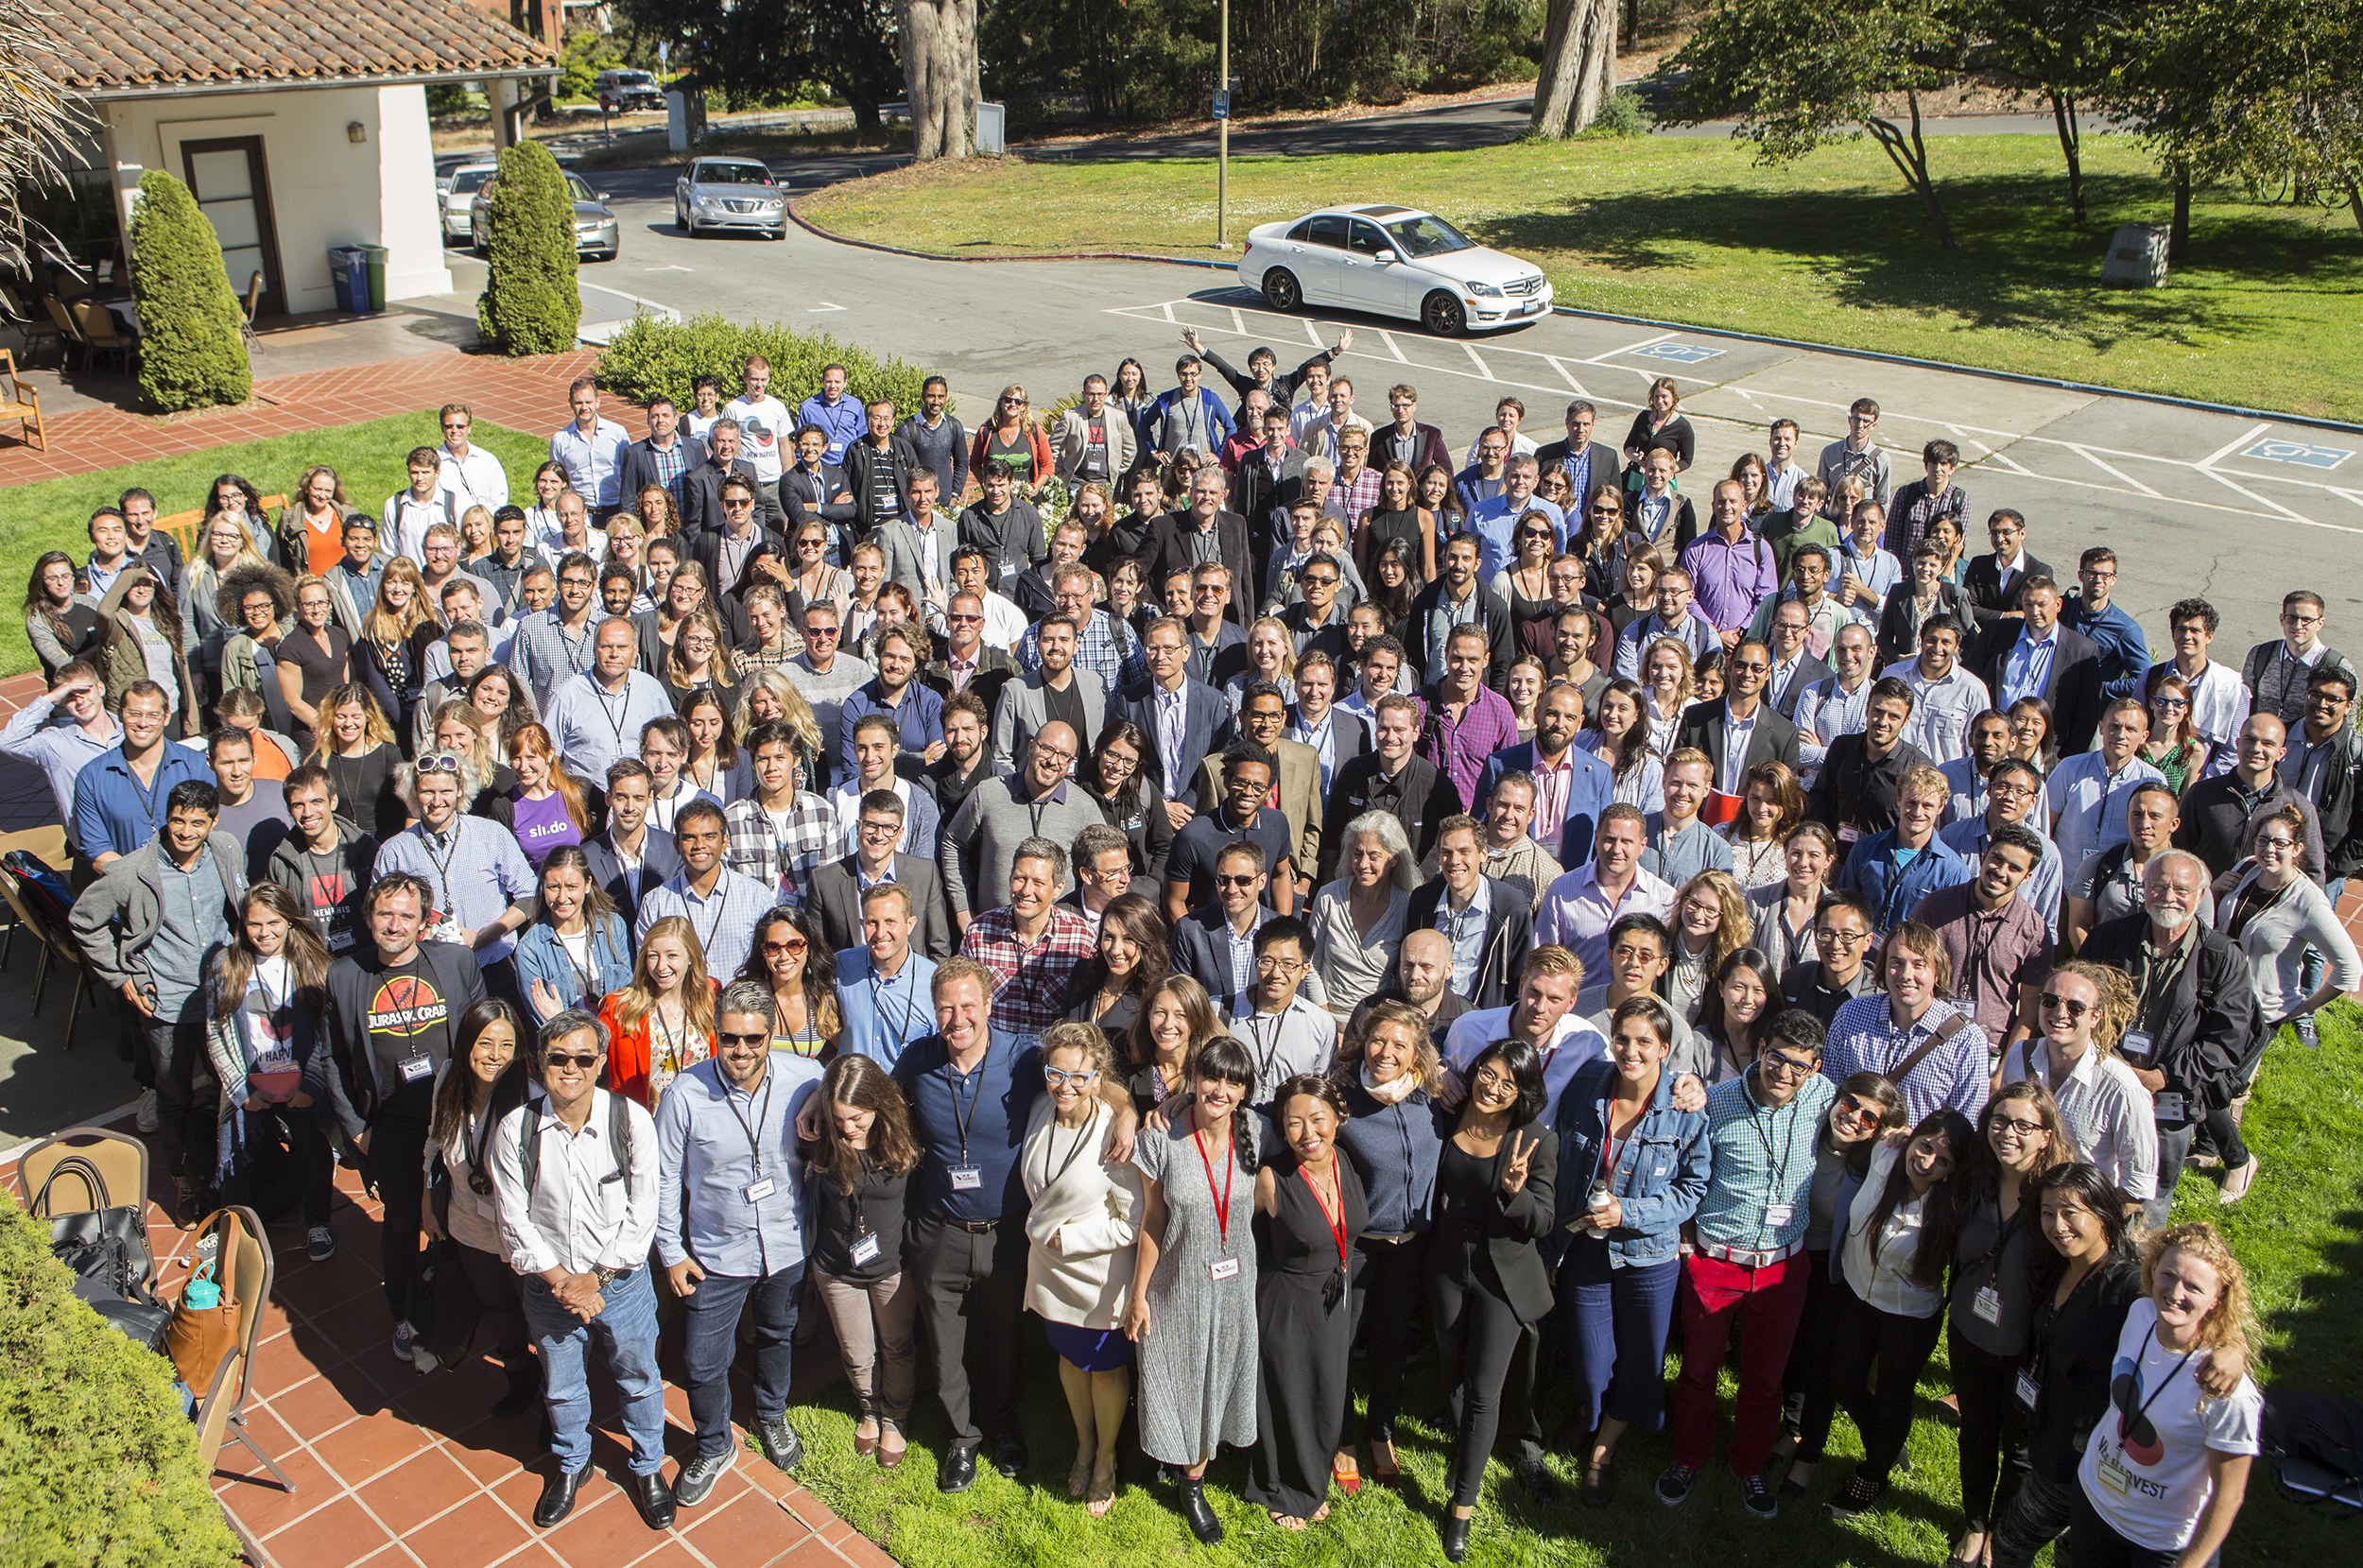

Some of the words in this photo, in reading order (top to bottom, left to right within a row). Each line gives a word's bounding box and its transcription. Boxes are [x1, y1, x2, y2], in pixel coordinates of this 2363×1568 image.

[759, 450, 776, 458] HARVES
[529, 820, 567, 837] sli.do
[313, 906, 351, 918] MEMPHIS
[417, 1004, 448, 1022] CRAB
